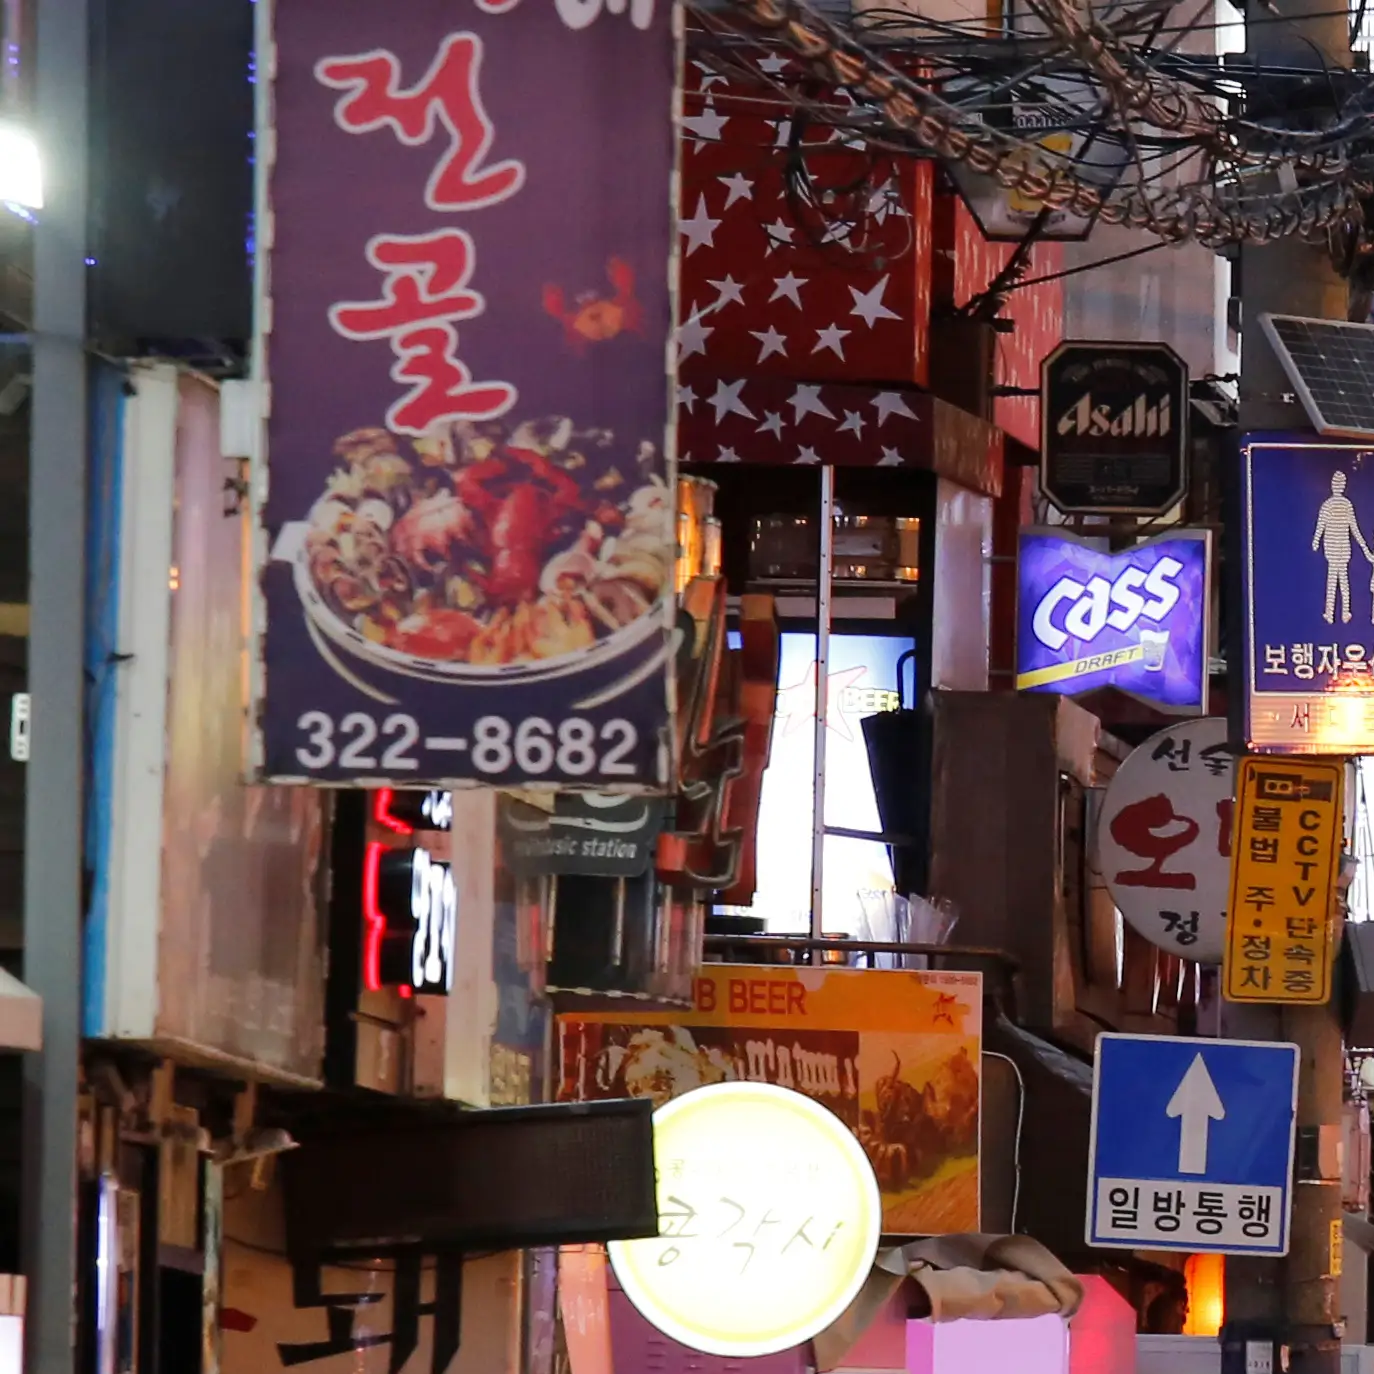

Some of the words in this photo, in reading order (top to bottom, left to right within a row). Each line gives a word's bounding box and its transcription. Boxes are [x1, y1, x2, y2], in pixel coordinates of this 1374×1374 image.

[314, 32, 526, 438] 전골
[1057, 392, 1170, 437] Asahi
[1074, 647, 1139, 674] DRAFT
[295, 710, 639, 777] 322-8682
[581, 838, 639, 860] station
[1251, 806, 1284, 864] 불법
[1292, 809, 1323, 906] CCTV
[1281, 917, 1320, 994] 단속중
[728, 978, 808, 1016] BEER
[1109, 1187, 1271, 1239] 일방통행
